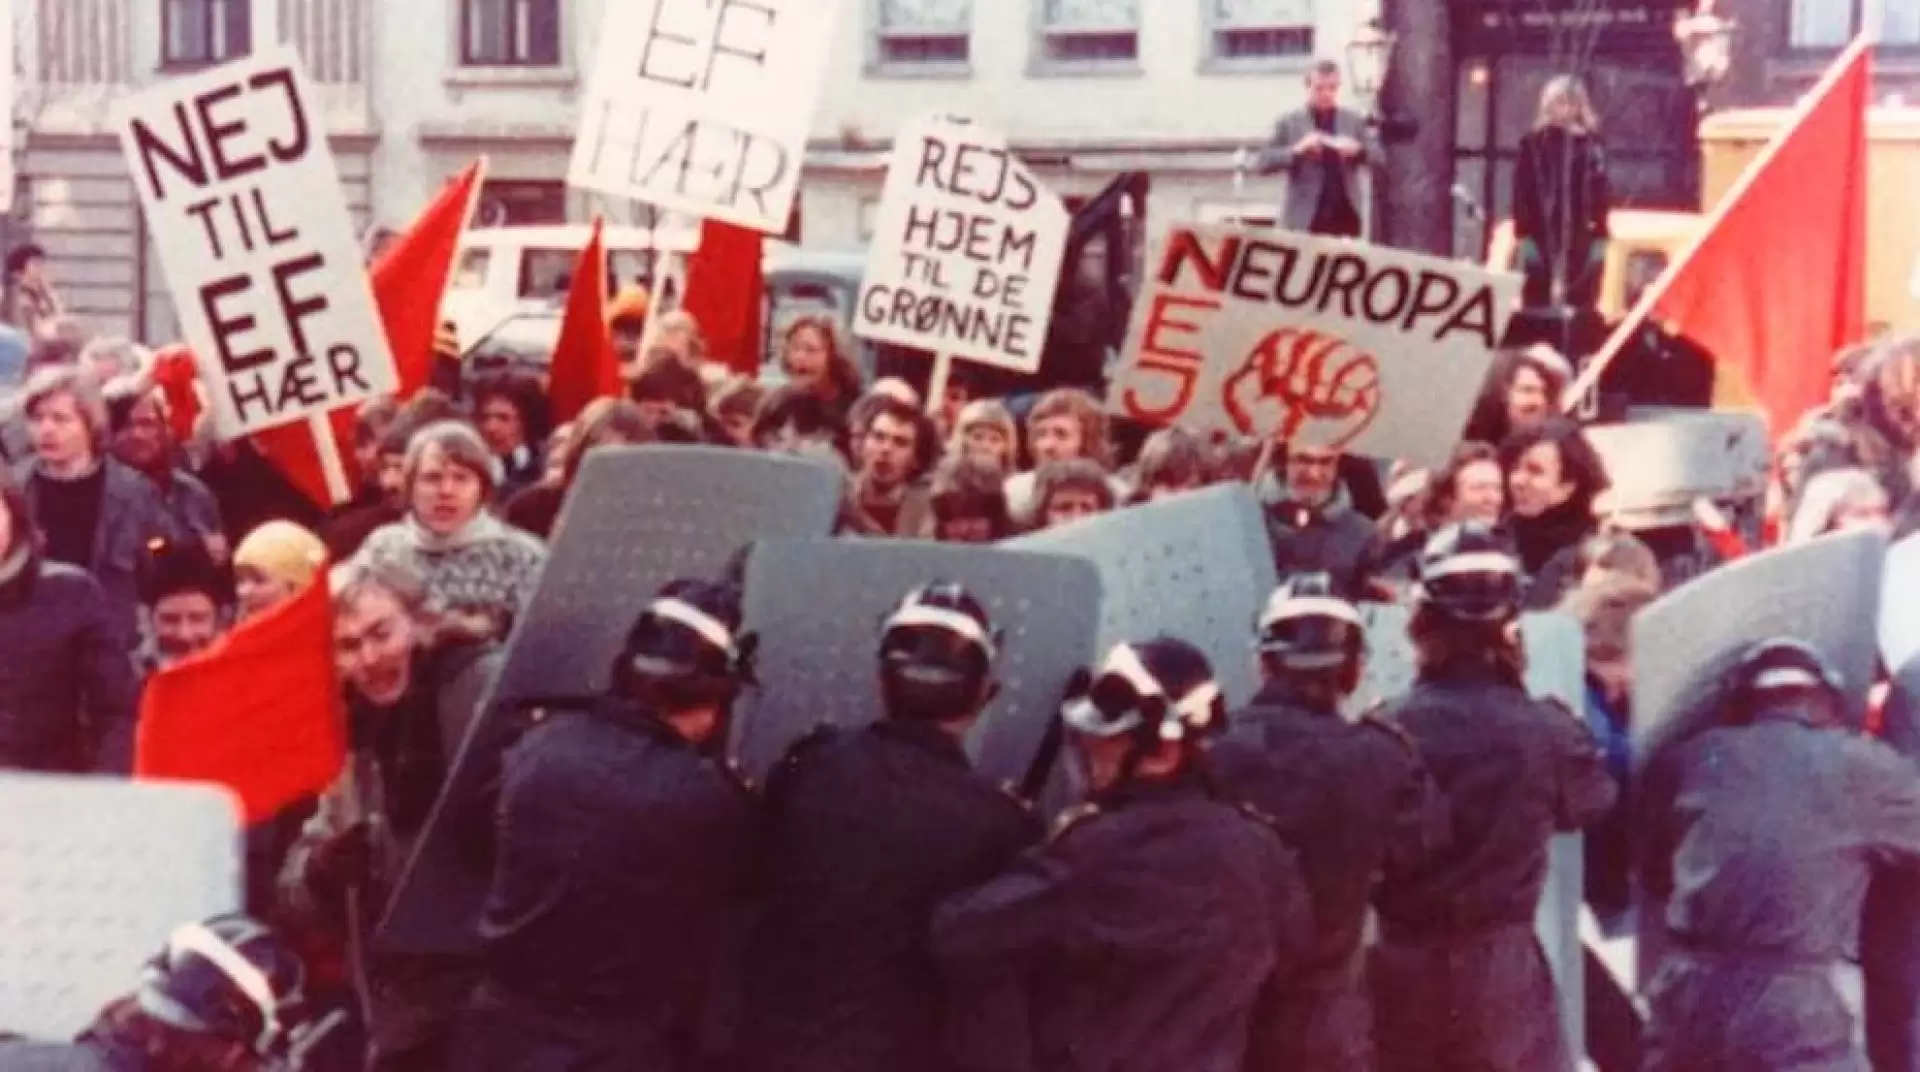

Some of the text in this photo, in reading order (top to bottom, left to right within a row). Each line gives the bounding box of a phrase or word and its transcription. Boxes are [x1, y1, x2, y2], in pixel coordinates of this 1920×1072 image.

[130, 67, 308, 200] NEJ
[916, 135, 1037, 211] REJS
[186, 187, 298, 258] TIL
[903, 205, 1036, 270] HJEM
[200, 251, 328, 375] EF
[902, 251, 1029, 309] TIL DE
[864, 284, 1032, 357] GRØNNE
[229, 342, 371, 421] HÆR
